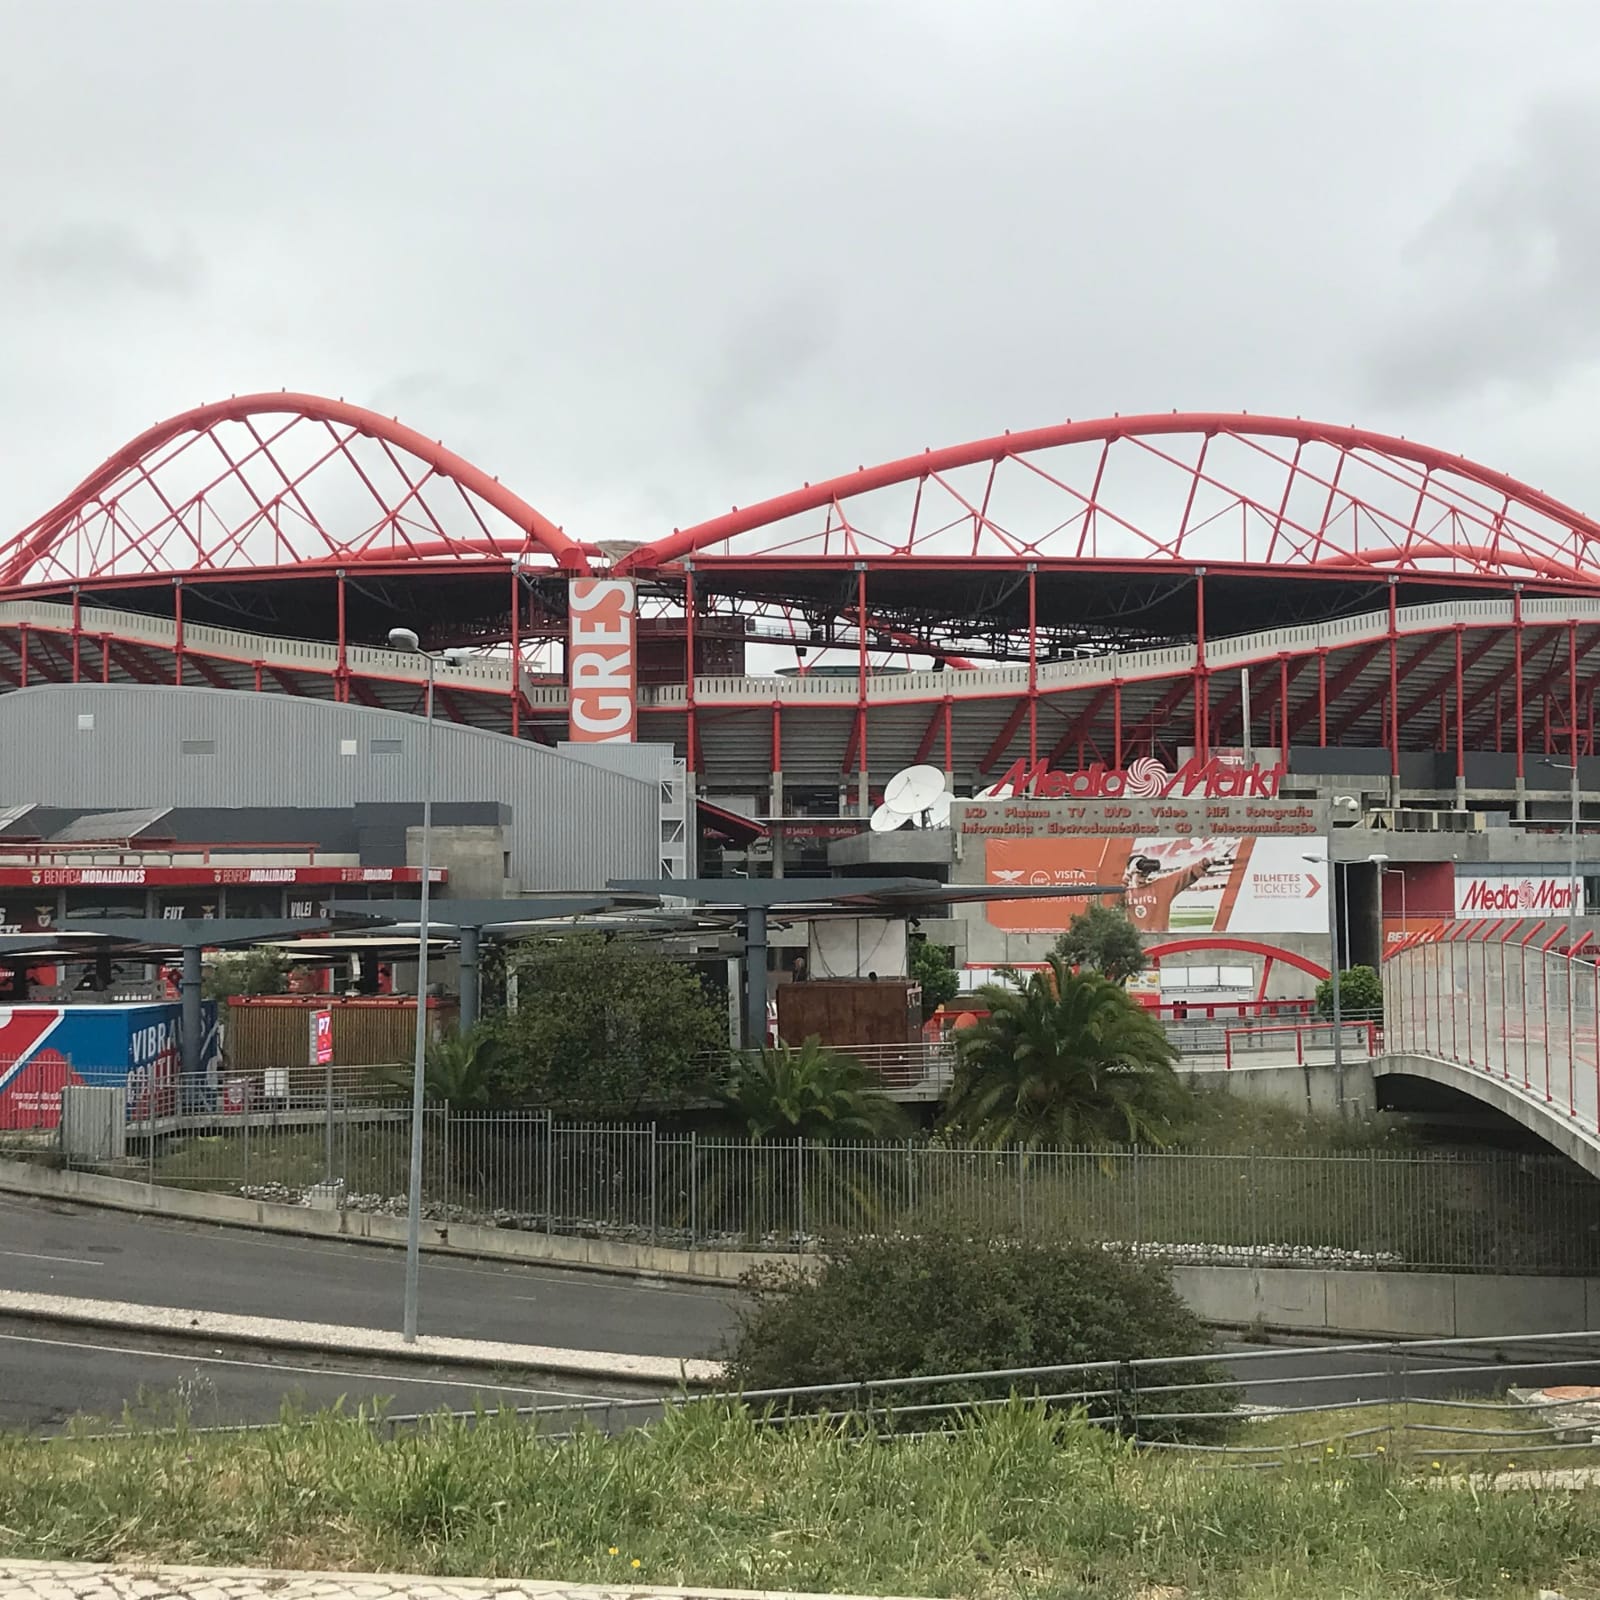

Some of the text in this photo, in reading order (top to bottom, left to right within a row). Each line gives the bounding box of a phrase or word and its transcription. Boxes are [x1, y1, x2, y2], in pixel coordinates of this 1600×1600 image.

[988, 756, 1287, 797] Media Markt
[964, 807, 987, 819] LCD
[1004, 806, 1050, 818] Plasma
[1067, 807, 1086, 818] TV
[1104, 807, 1131, 818] DVD
[1246, 806, 1313, 820] Fotografia
[961, 821, 1317, 834] Informática Electrodomésticos CD Telecomunicação
[1054, 870, 1086, 879] VISITA
[1253, 873, 1301, 882] BILHETES
[1253, 883, 1301, 894] TICKETS
[1461, 879, 1519, 910] Media
[318, 1016, 331, 1036] P7
